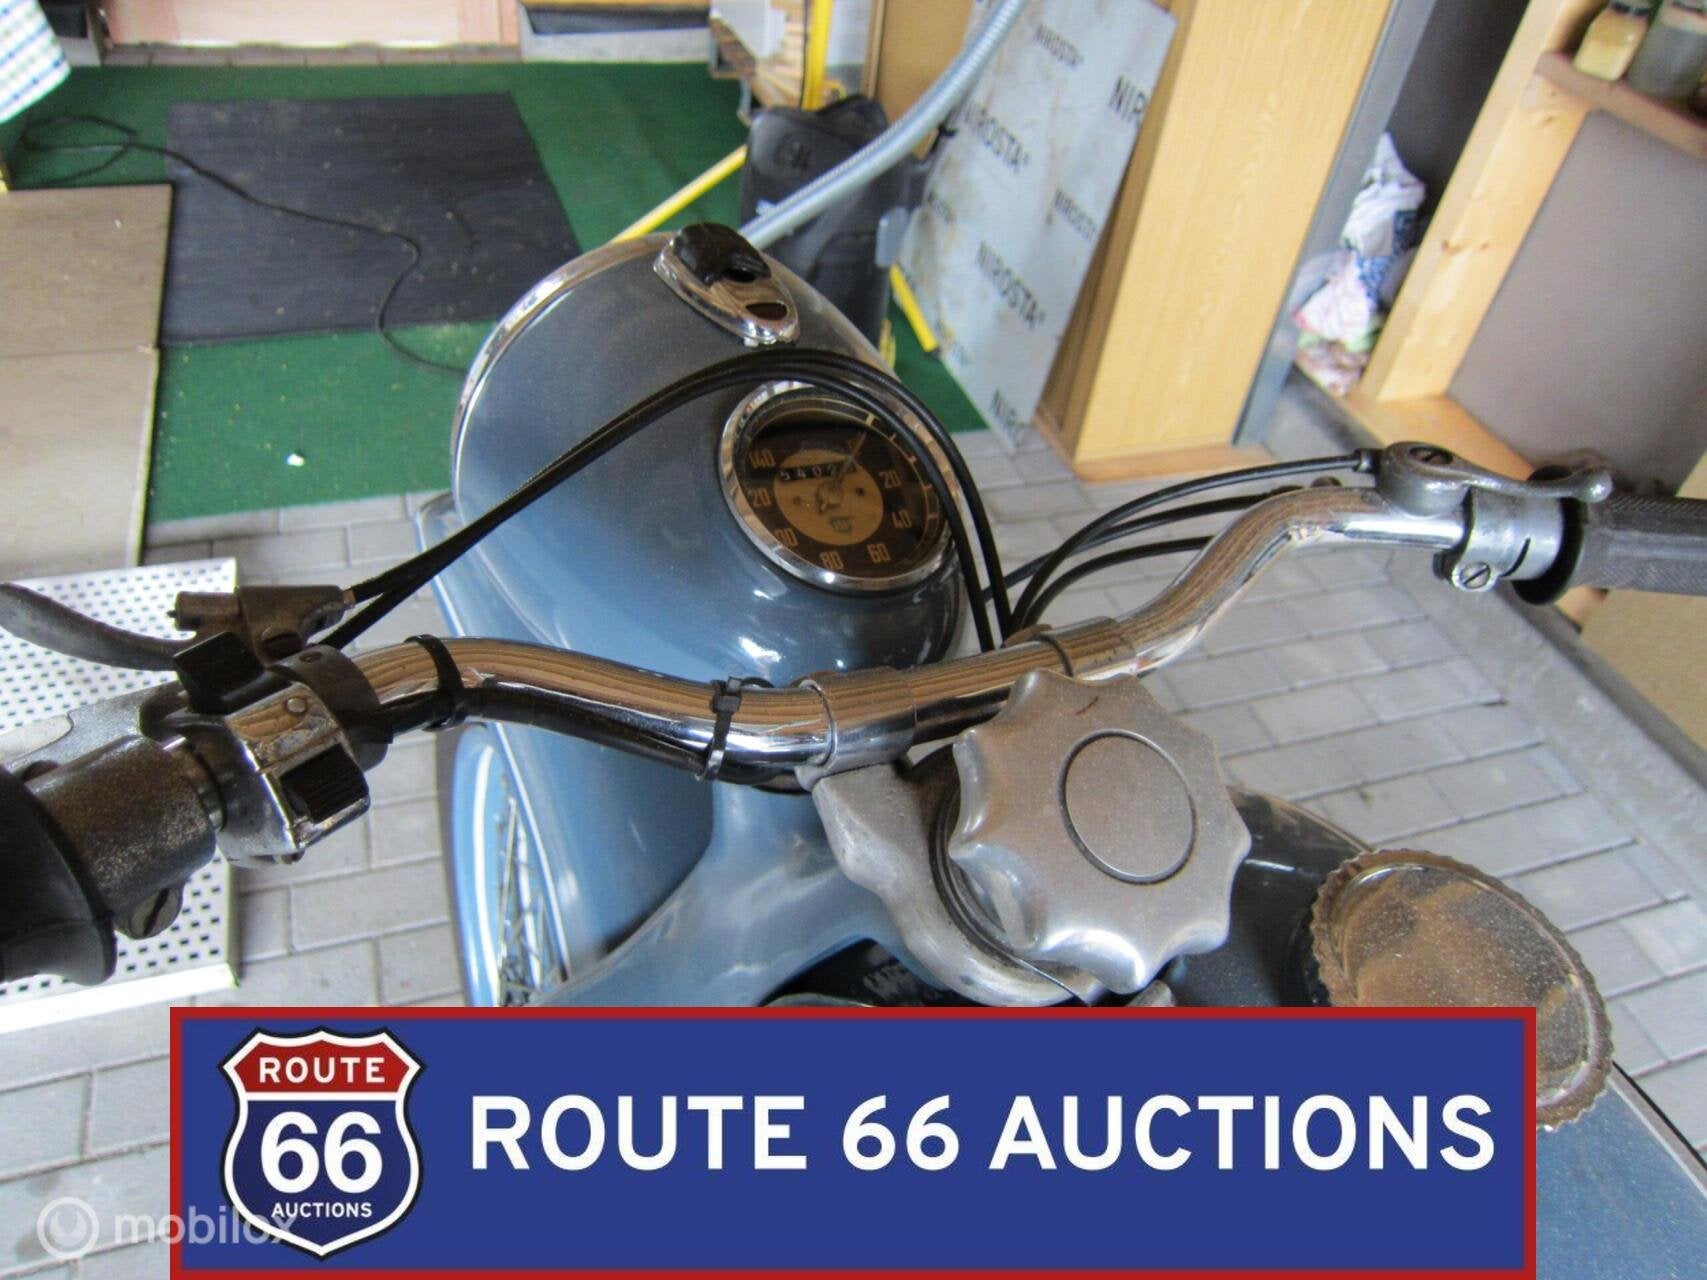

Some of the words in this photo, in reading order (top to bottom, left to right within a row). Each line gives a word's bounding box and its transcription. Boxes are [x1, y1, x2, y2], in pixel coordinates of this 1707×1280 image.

[879, 469, 901, 489] 20
[891, 510, 913, 529] 40
[819, 550, 844, 570] 80
[866, 542, 892, 564] 60
